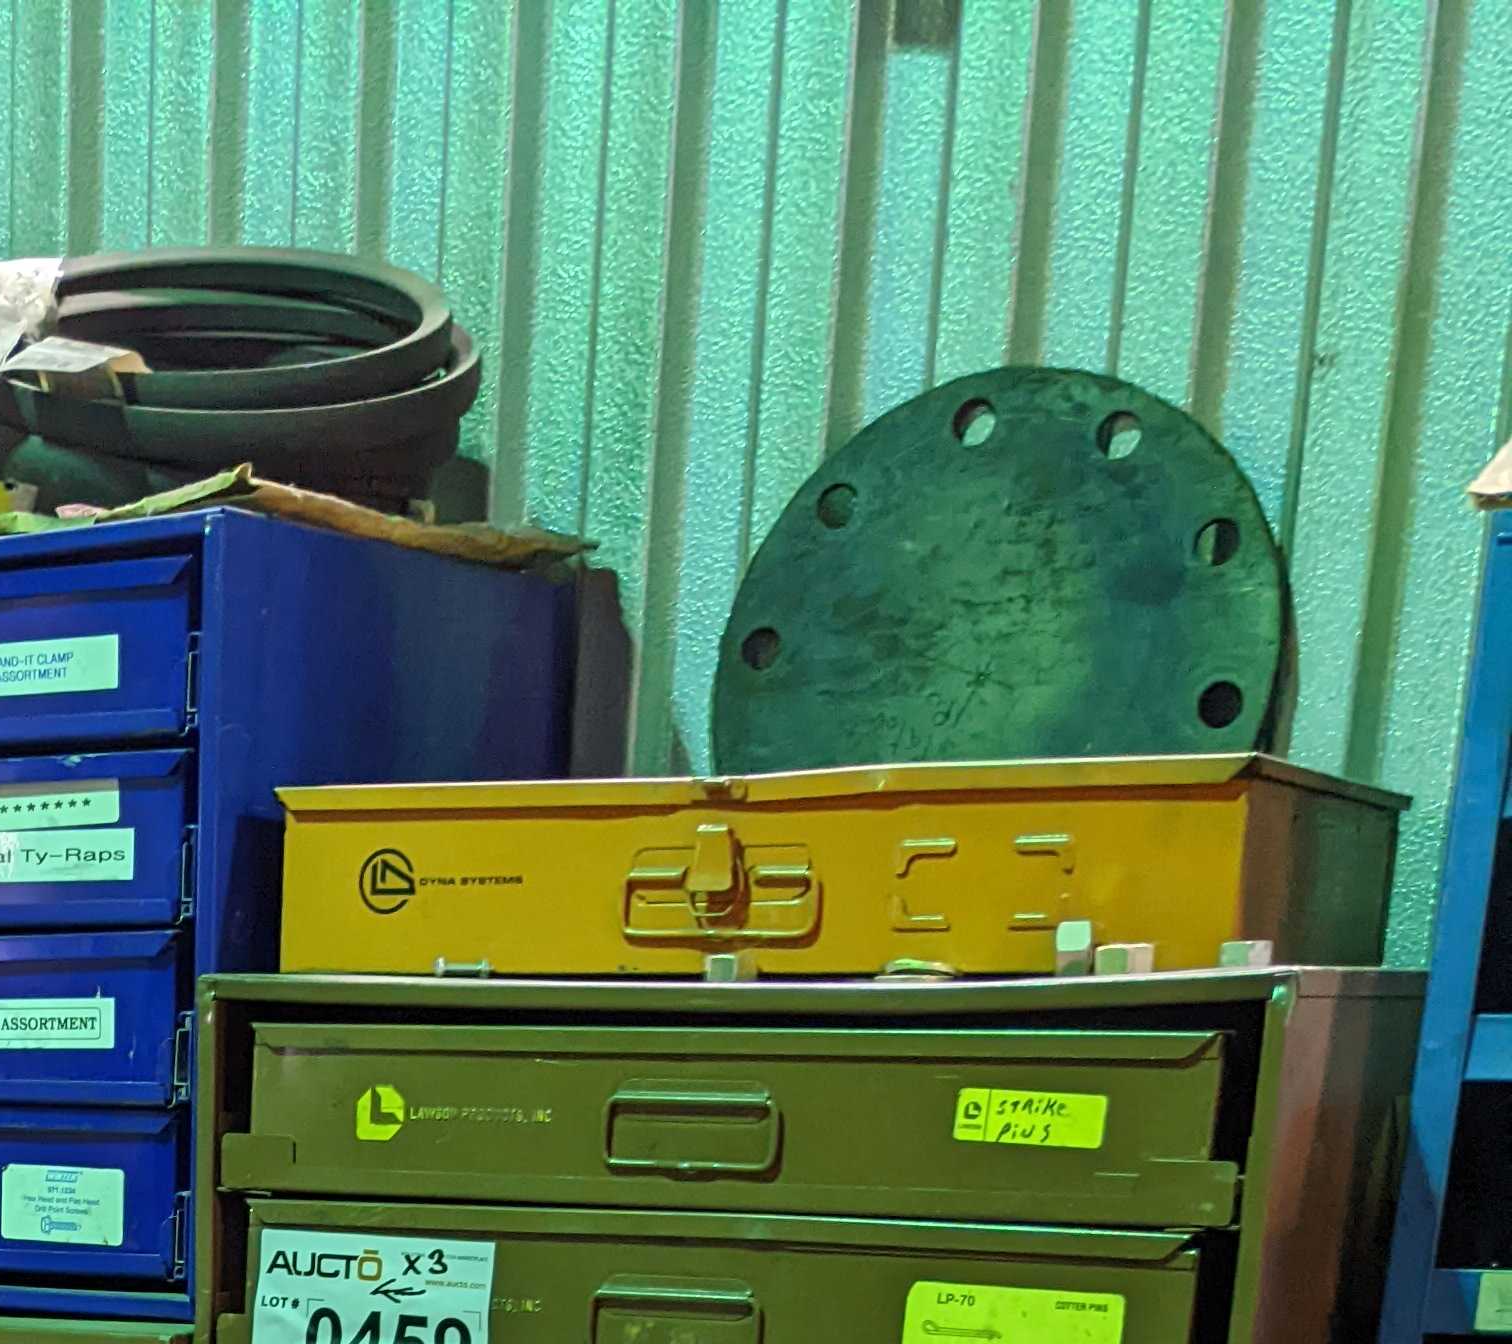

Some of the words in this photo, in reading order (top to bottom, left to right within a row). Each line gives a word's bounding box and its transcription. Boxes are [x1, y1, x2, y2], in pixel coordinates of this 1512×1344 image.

[38, 652, 74, 665] CLAMP
[21, 848, 126, 865] Ty-Raps
[1, 1017, 97, 1031] ASSORTMENT
[261, 1295, 287, 1308] LOT
[937, 1293, 976, 1307] LP-70
